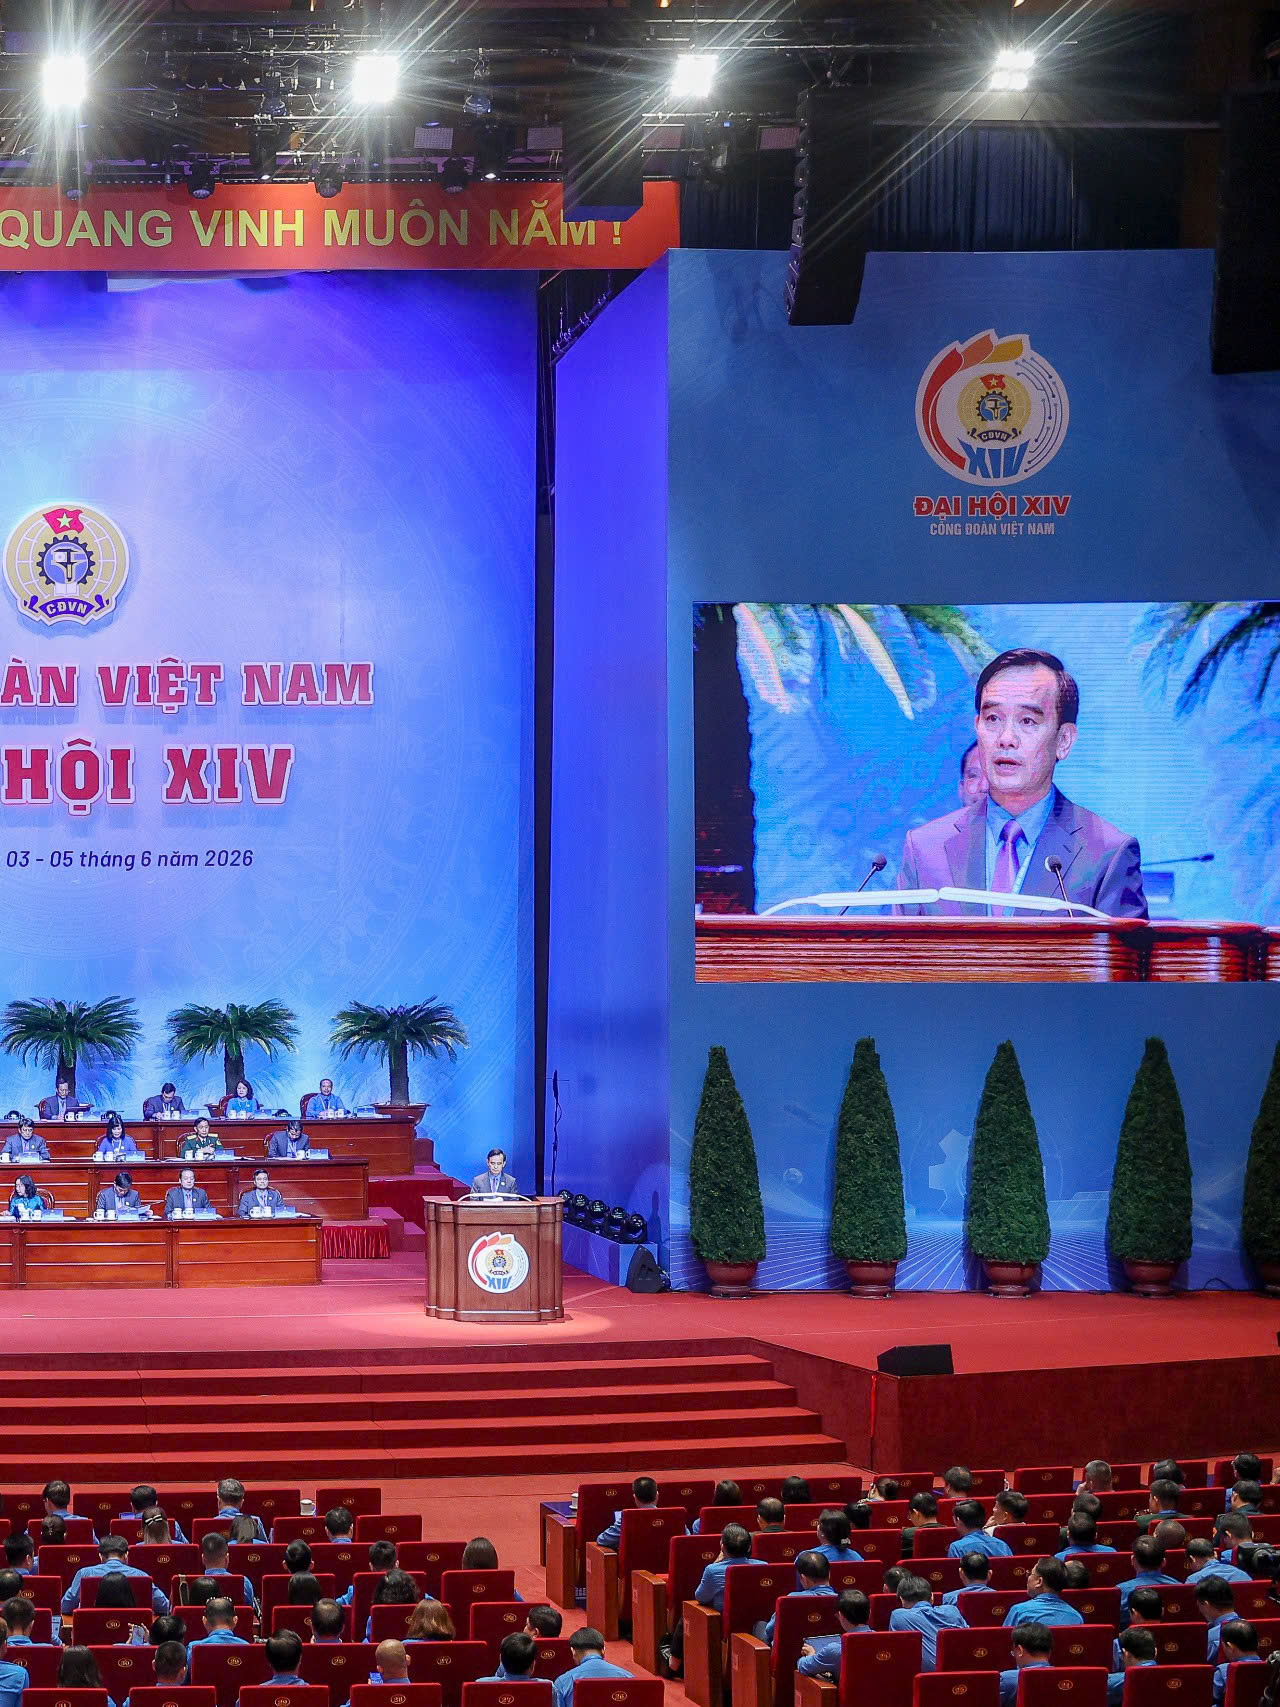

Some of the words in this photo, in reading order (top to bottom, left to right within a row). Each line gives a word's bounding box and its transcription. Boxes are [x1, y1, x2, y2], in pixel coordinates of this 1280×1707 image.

[190, 208, 304, 247] VINH
[323, 199, 469, 247] MUÔN
[489, 200, 596, 246] NĂM
[957, 438, 1030, 479] XIV
[913, 496, 962, 520] ĐẠI
[967, 491, 1017, 520] HỘI
[1022, 495, 1072, 517] XIV
[930, 521, 962, 536] CÔNG
[965, 521, 997, 536] ĐOÀN
[1000, 521, 1023, 538] VIỆT
[1027, 522, 1055, 535] NAM
[46, 601, 88, 614] CĐVN
[96, 656, 225, 715] VIỆT
[241, 660, 375, 707] NAM
[0, 738, 136, 816] HỘI
[162, 744, 296, 806] XIV
[6, 850, 30, 867] 03
[50, 850, 73, 867] 05
[80, 850, 136, 871] tháng
[141, 850, 151, 867] 6
[157, 850, 199, 867] năm
[205, 849, 254, 867] 2026
